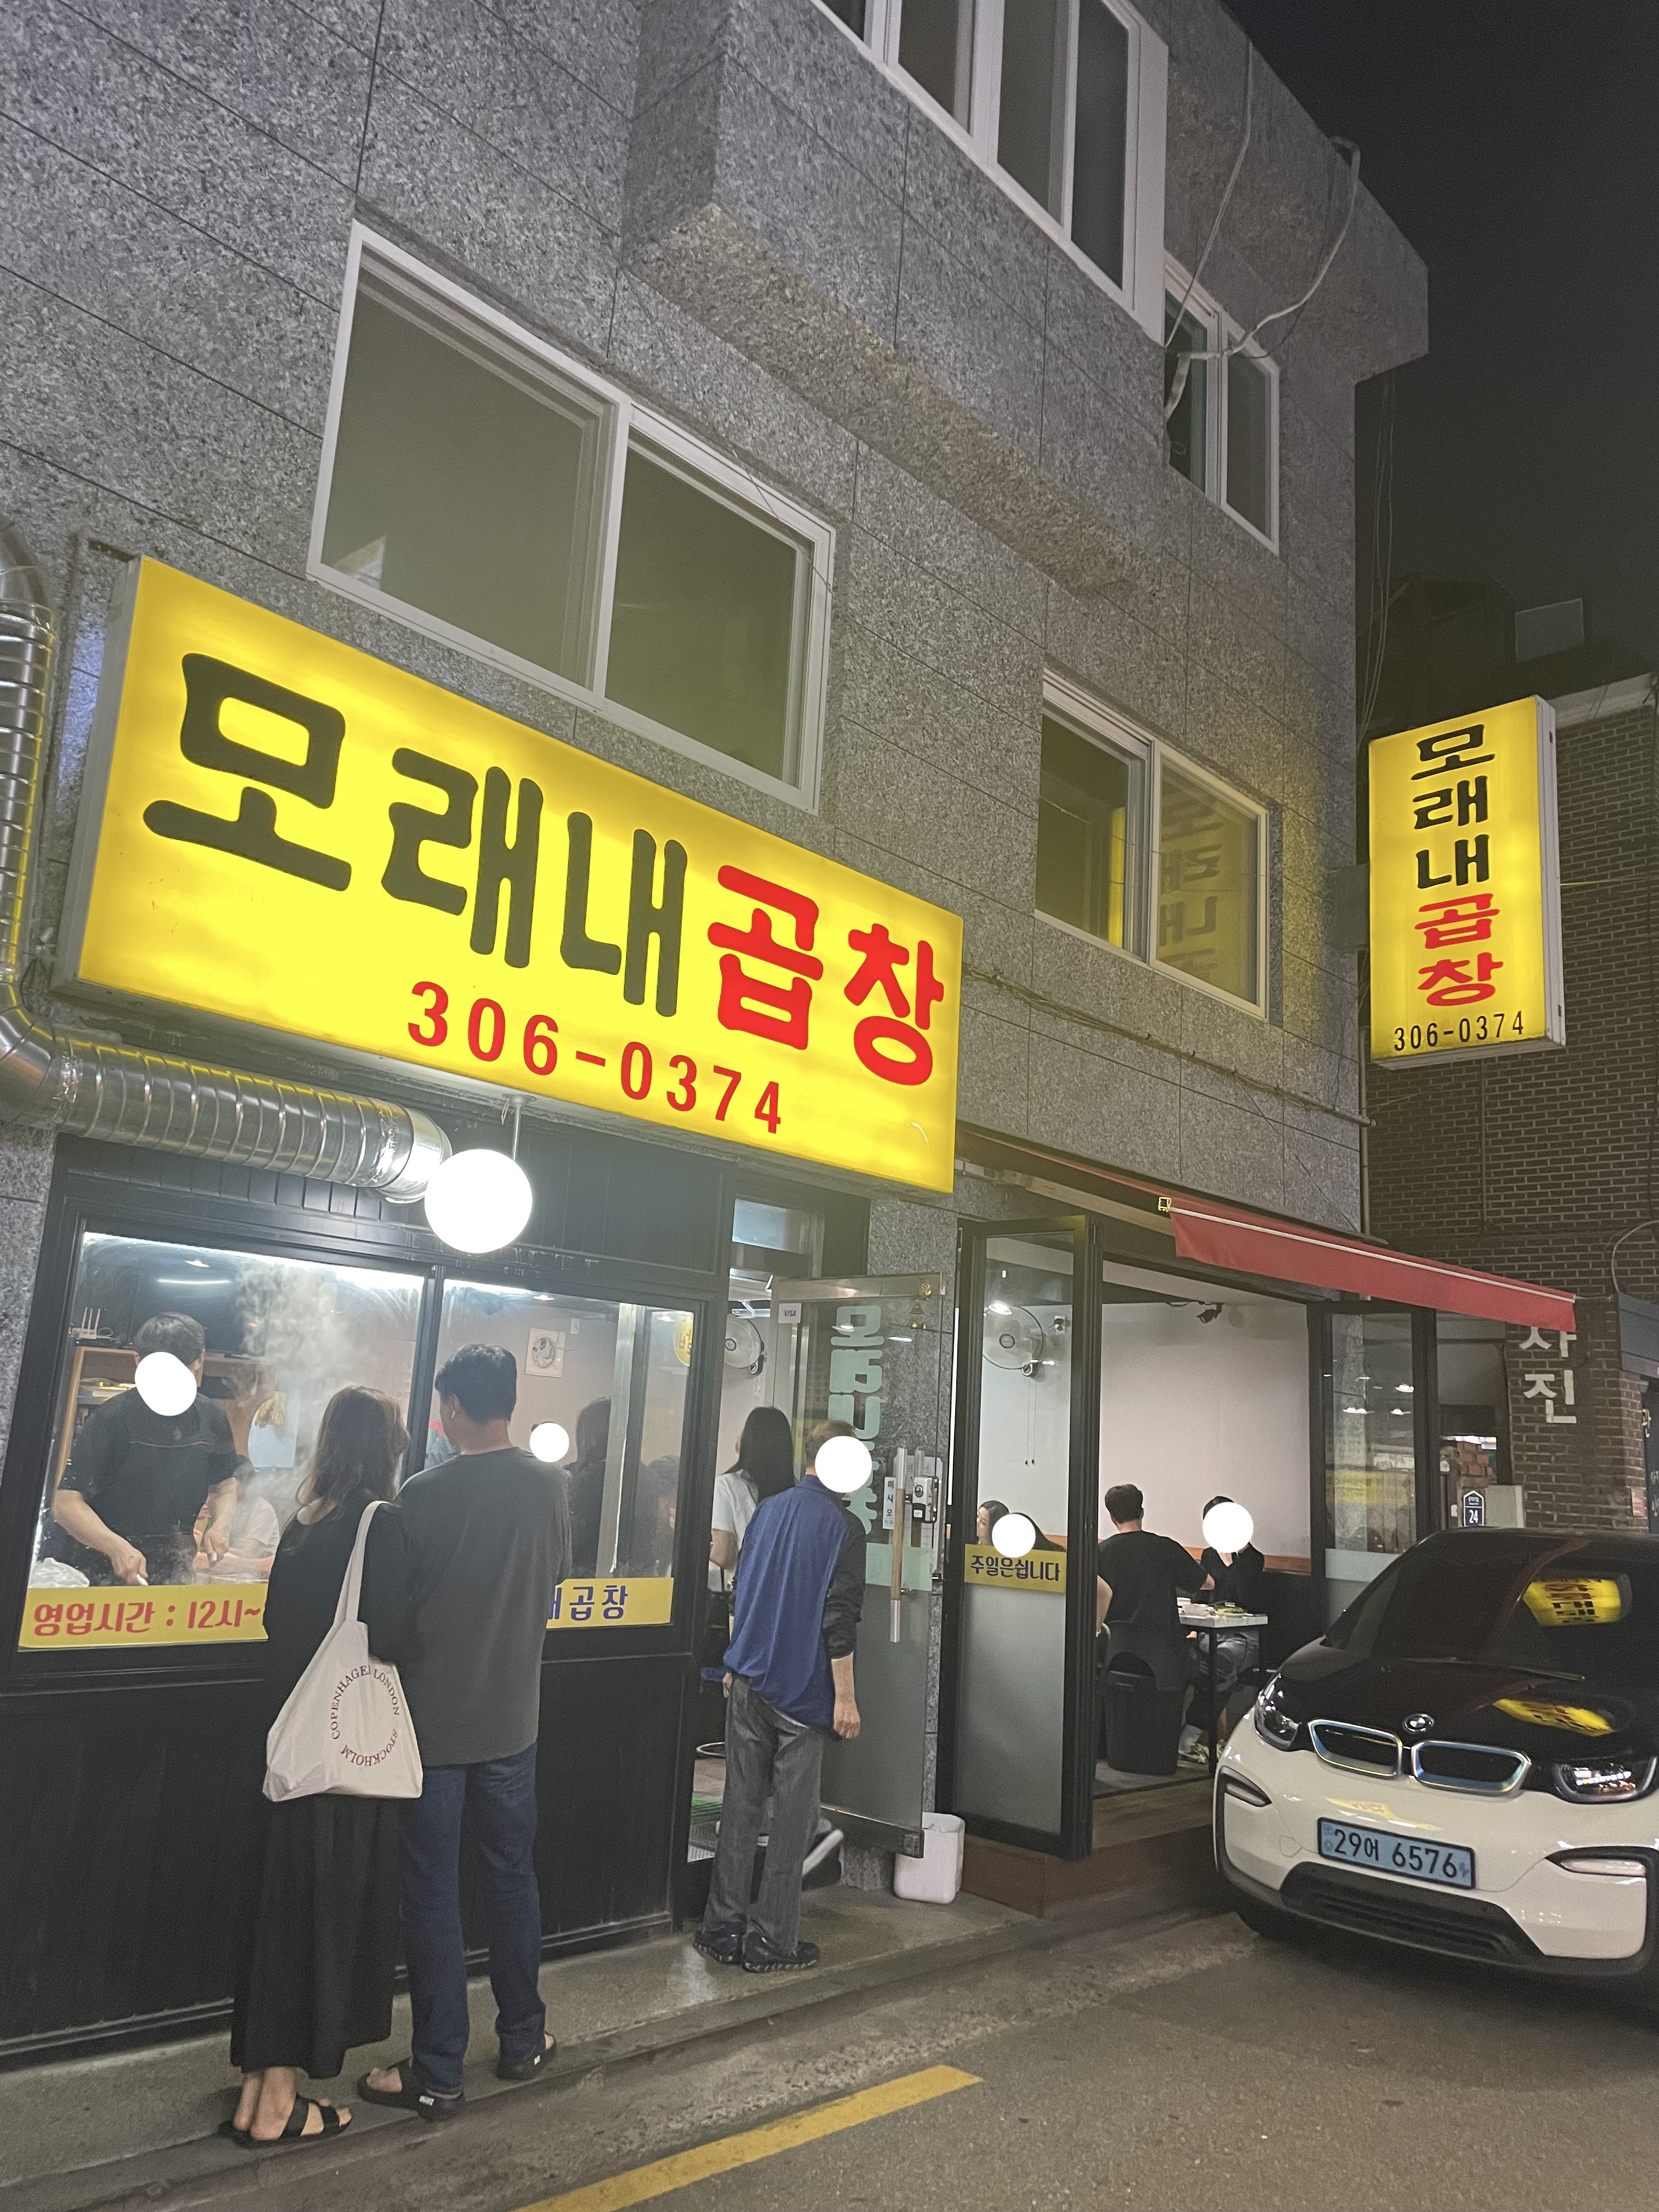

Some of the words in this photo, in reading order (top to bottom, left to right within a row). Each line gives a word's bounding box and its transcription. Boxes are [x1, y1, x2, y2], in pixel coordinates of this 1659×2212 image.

[1394, 1010, 1524, 1052] 306-0374
[407, 981, 782, 1134] 306-0374
[1469, 1509, 1479, 1523] 24
[34, 1601, 155, 1637] 영업시간
[331, 1665, 371, 1740] COPENHAGE
[374, 1669, 399, 1716] LONDON
[340, 1728, 398, 1767] STOCKHOLM
[1392, 1842, 1458, 1878] 6576
